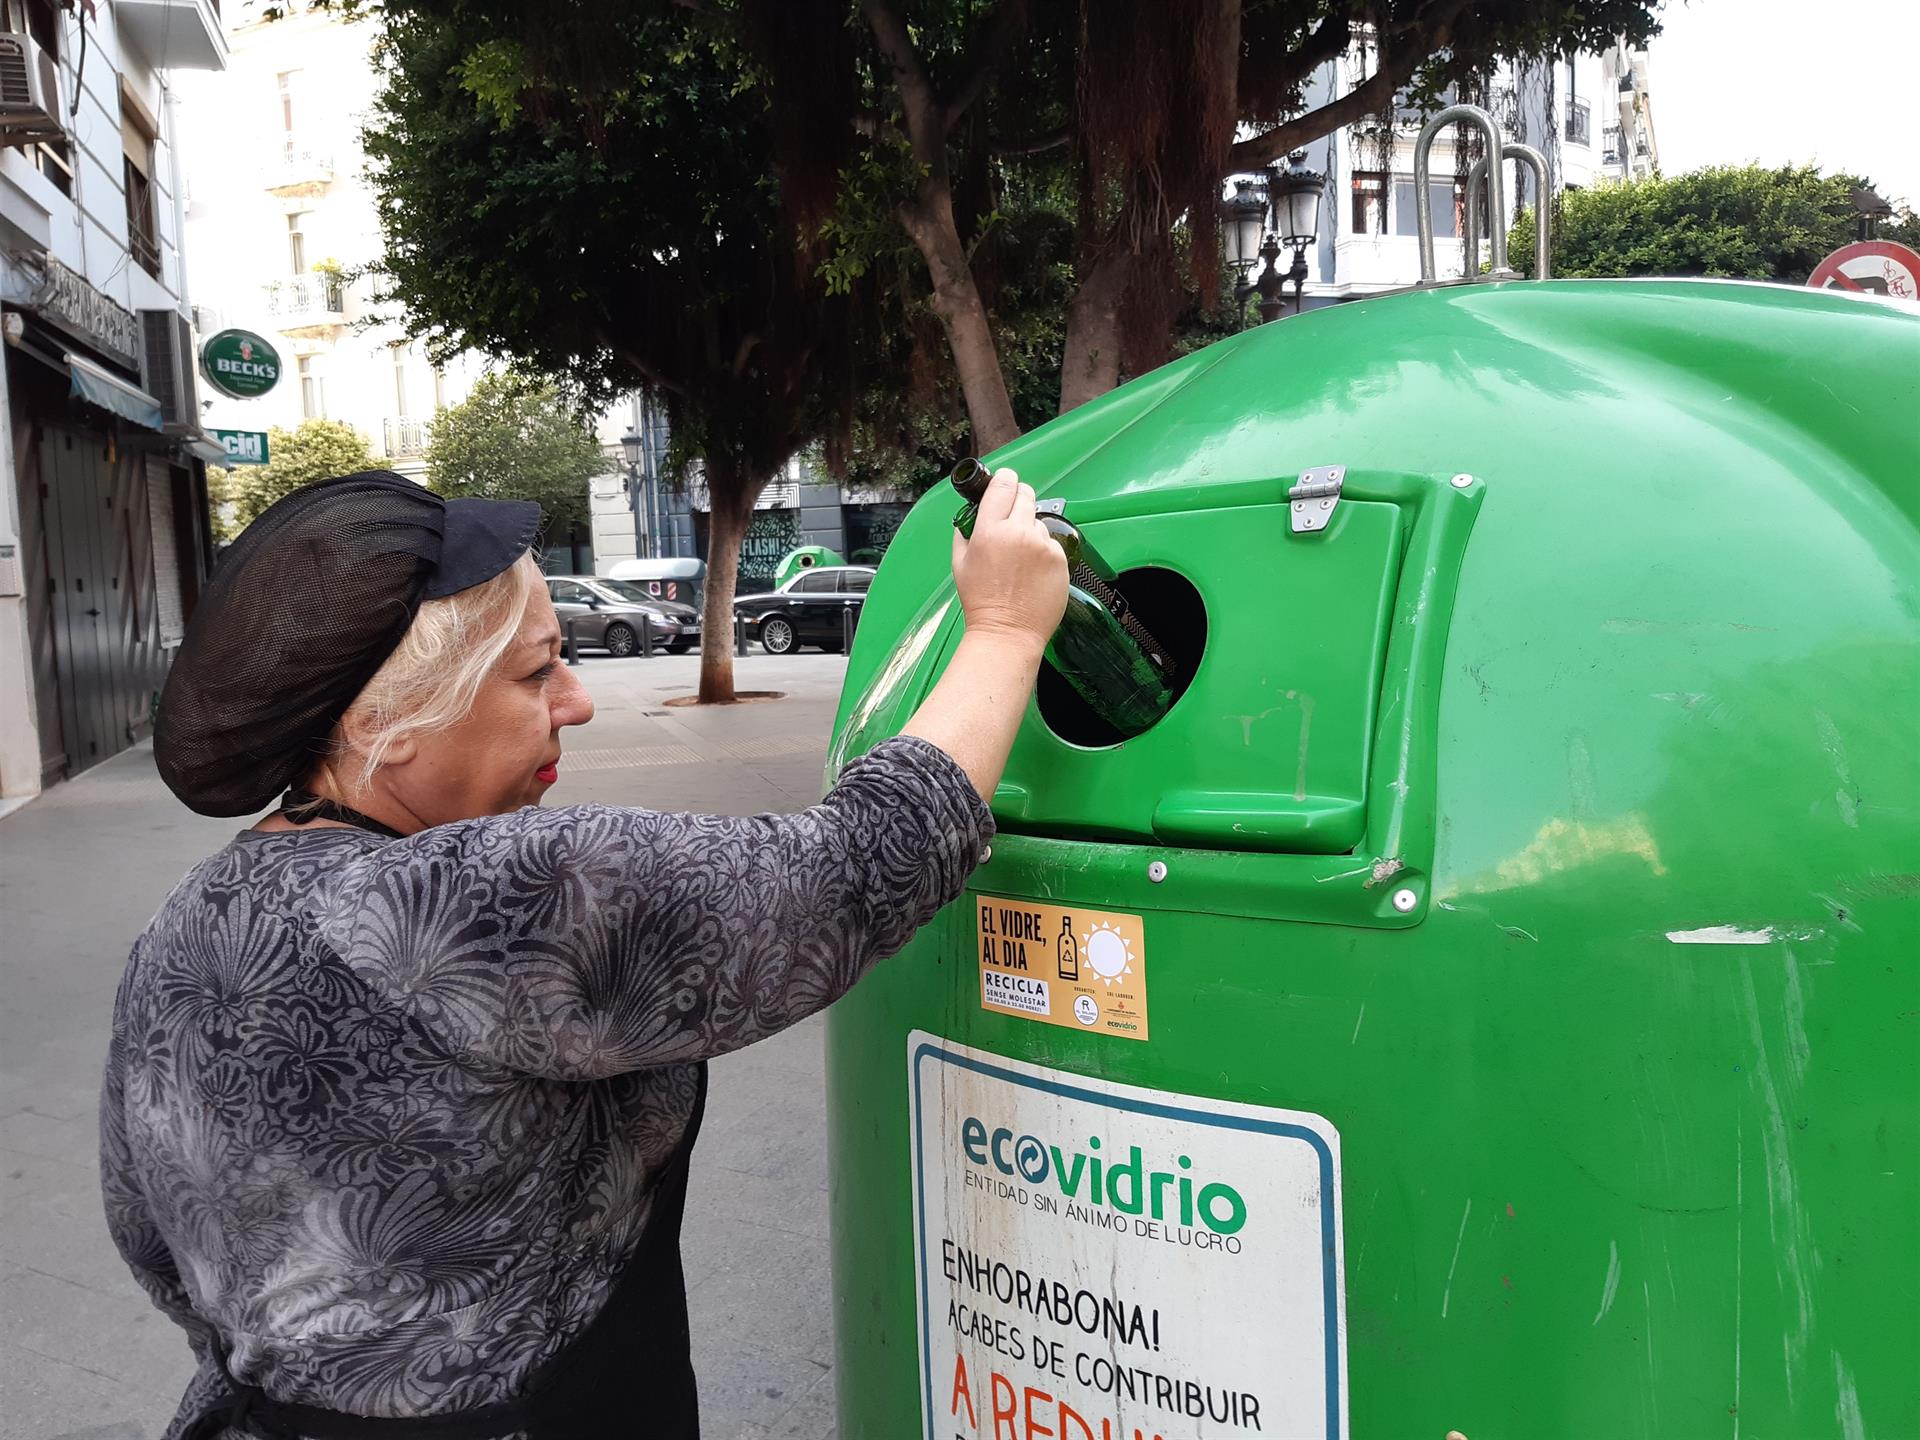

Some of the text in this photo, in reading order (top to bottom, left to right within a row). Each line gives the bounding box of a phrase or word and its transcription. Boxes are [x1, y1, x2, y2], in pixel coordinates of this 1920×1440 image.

[217, 358, 277, 379] BECK'S
[742, 538, 780, 556] FLASH!
[981, 906, 1047, 947] EL VIDRE,
[983, 937, 1028, 971] AL DIA
[985, 972, 1045, 997] RECICLA
[986, 989, 1046, 1007] SENSE MOLESTAR
[1107, 1020, 1138, 1031] ecovidrio
[962, 1117, 1247, 1235] ecovidrio
[965, 1169, 1242, 1255] ENTIDAD SIN ÁNIMO DE LUCRO
[942, 1238, 1160, 1352] ENHORABONA!
[948, 1299, 1262, 1431] ACABES DE CONTRIBUIR
[951, 1353, 976, 1429] A
